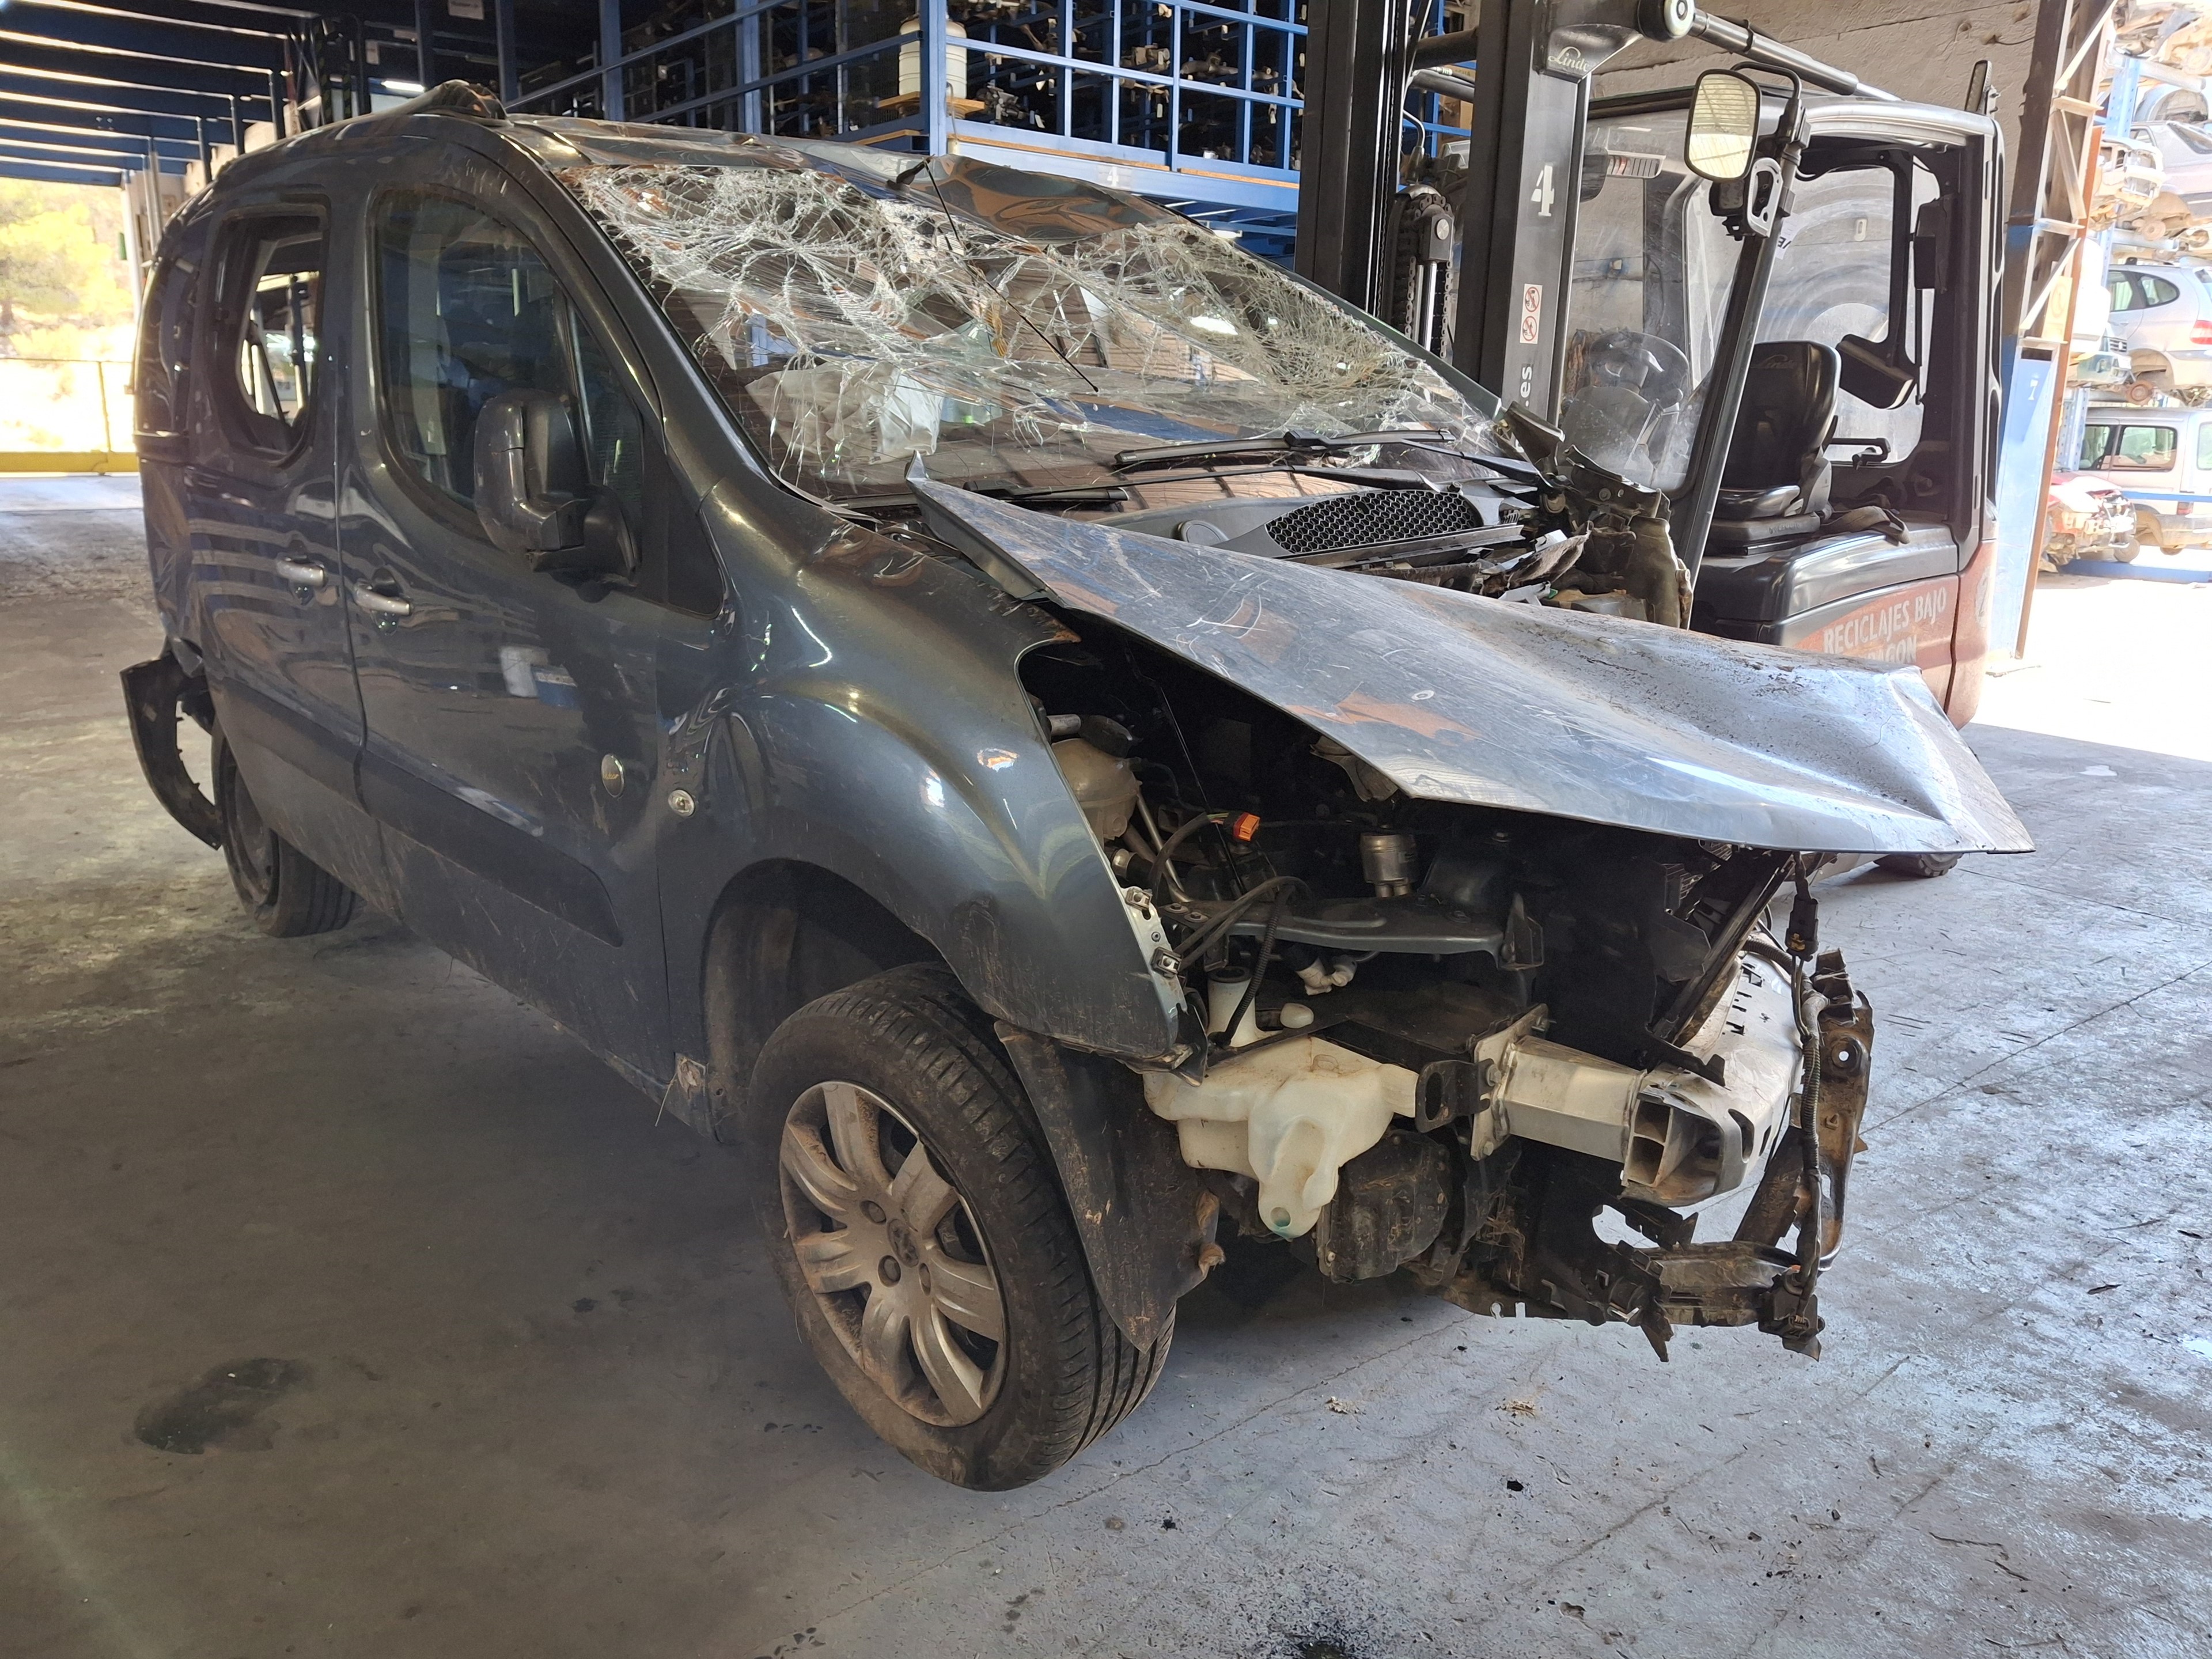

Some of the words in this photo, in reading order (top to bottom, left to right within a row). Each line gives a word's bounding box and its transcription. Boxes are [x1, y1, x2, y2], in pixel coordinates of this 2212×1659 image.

[1547, 46, 1589, 72] Linde
[1107, 166, 1119, 187] 4
[1531, 164, 1555, 217] 4
[1824, 600, 1910, 653] RECICLAJES
[1914, 586, 1947, 625] BAJO
